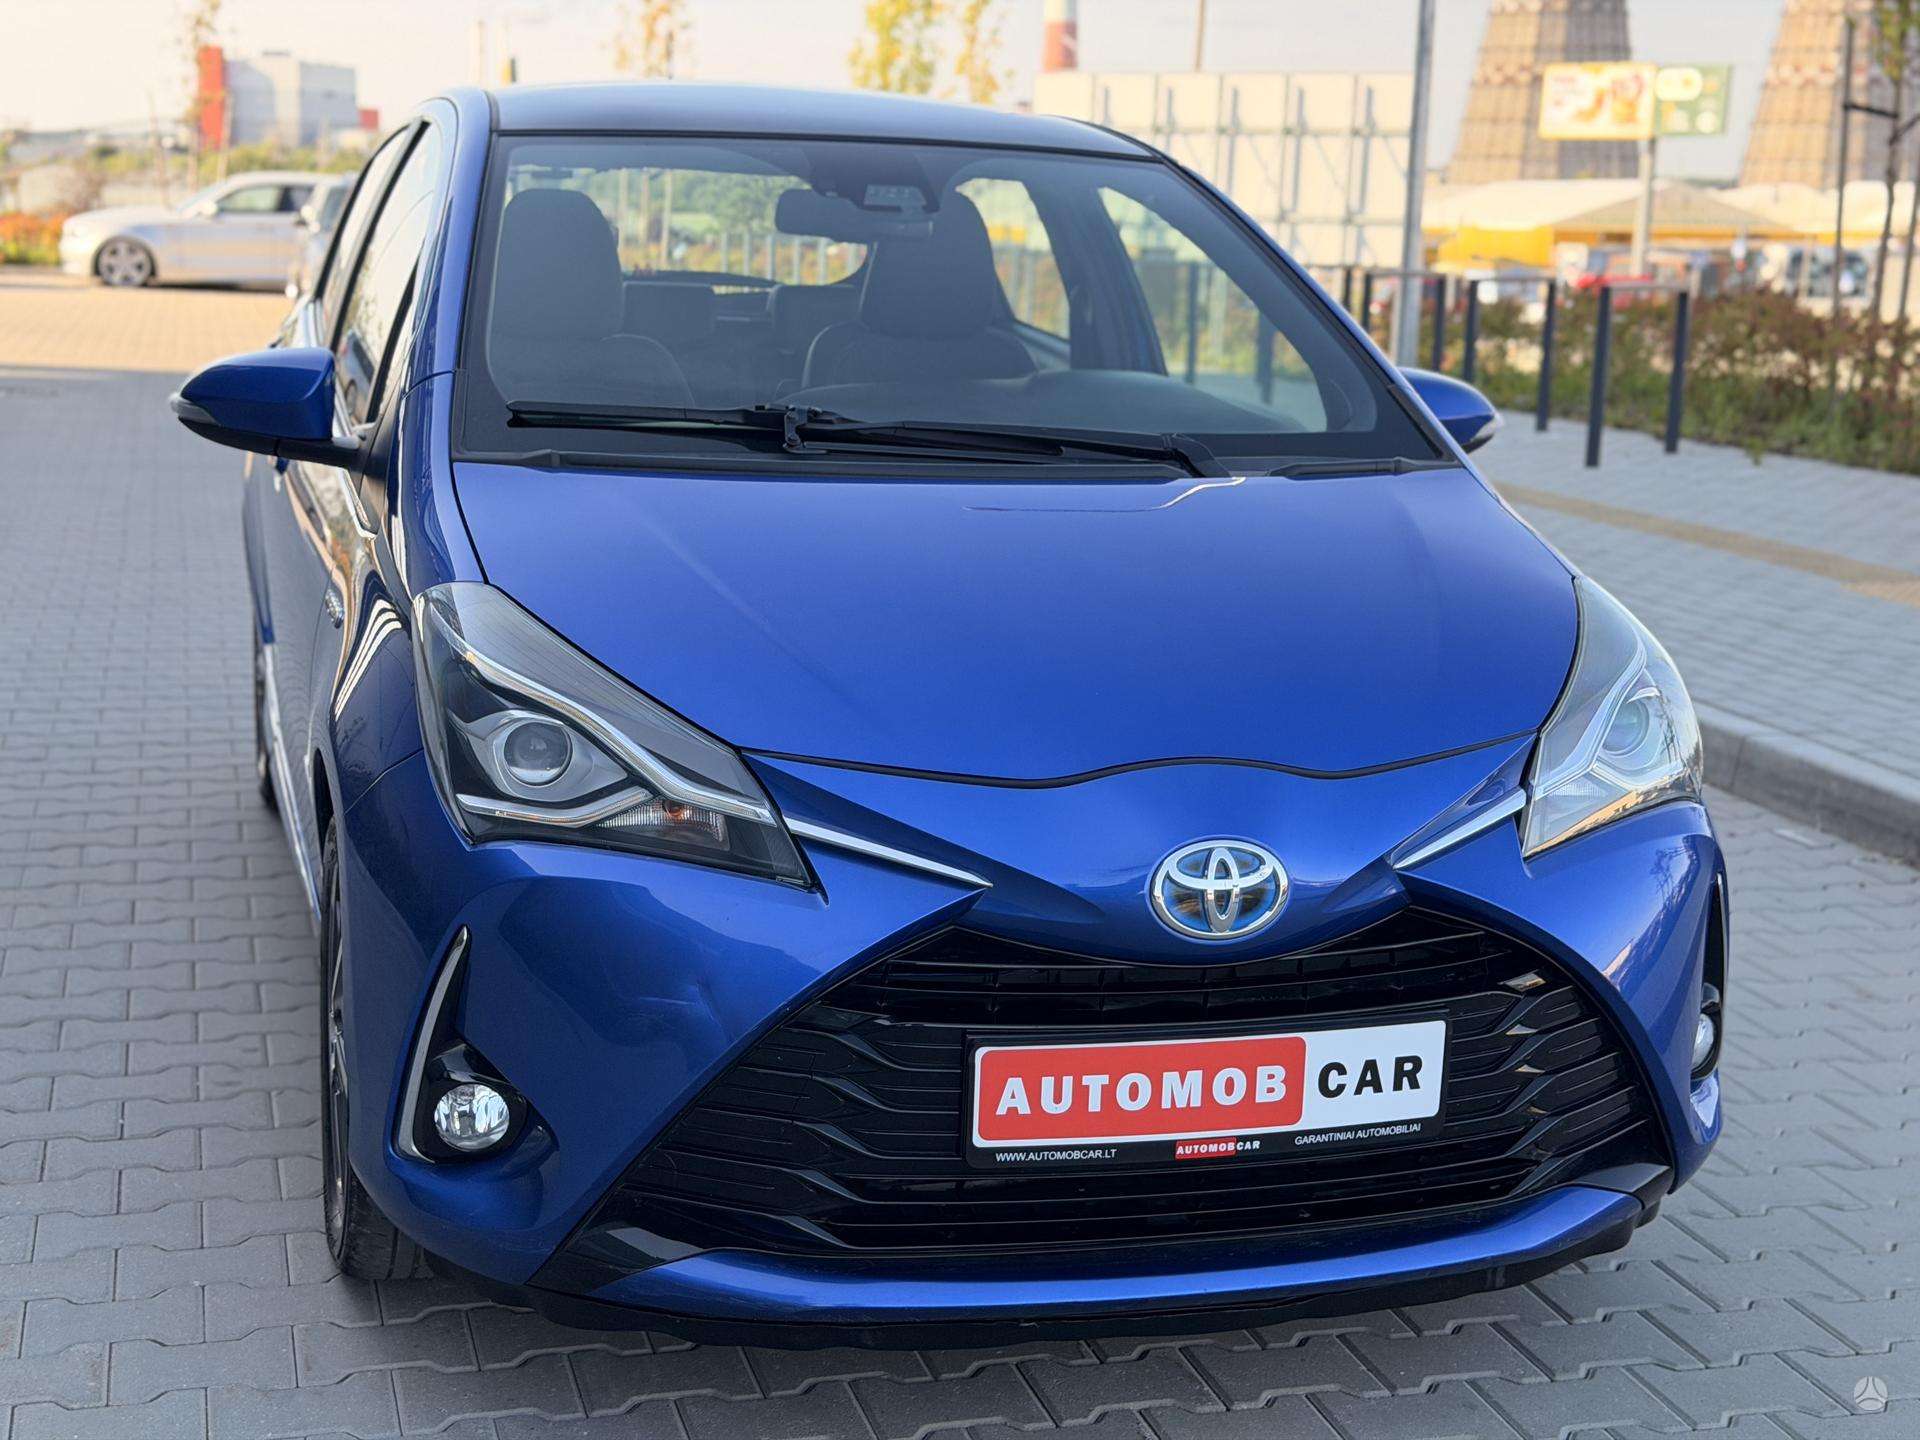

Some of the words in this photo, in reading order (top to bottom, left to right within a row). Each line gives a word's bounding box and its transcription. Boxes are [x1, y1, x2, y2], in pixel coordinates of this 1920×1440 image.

[995, 1064, 1287, 1116] AUTOMOB
[1317, 1054, 1424, 1099] CAR
[1294, 1131, 1355, 1146] GARANTINIAI
[1355, 1123, 1422, 1138] AUTOMOBILIAI
[995, 1149, 1118, 1162] WWW.AUTOMOBCAR.LT
